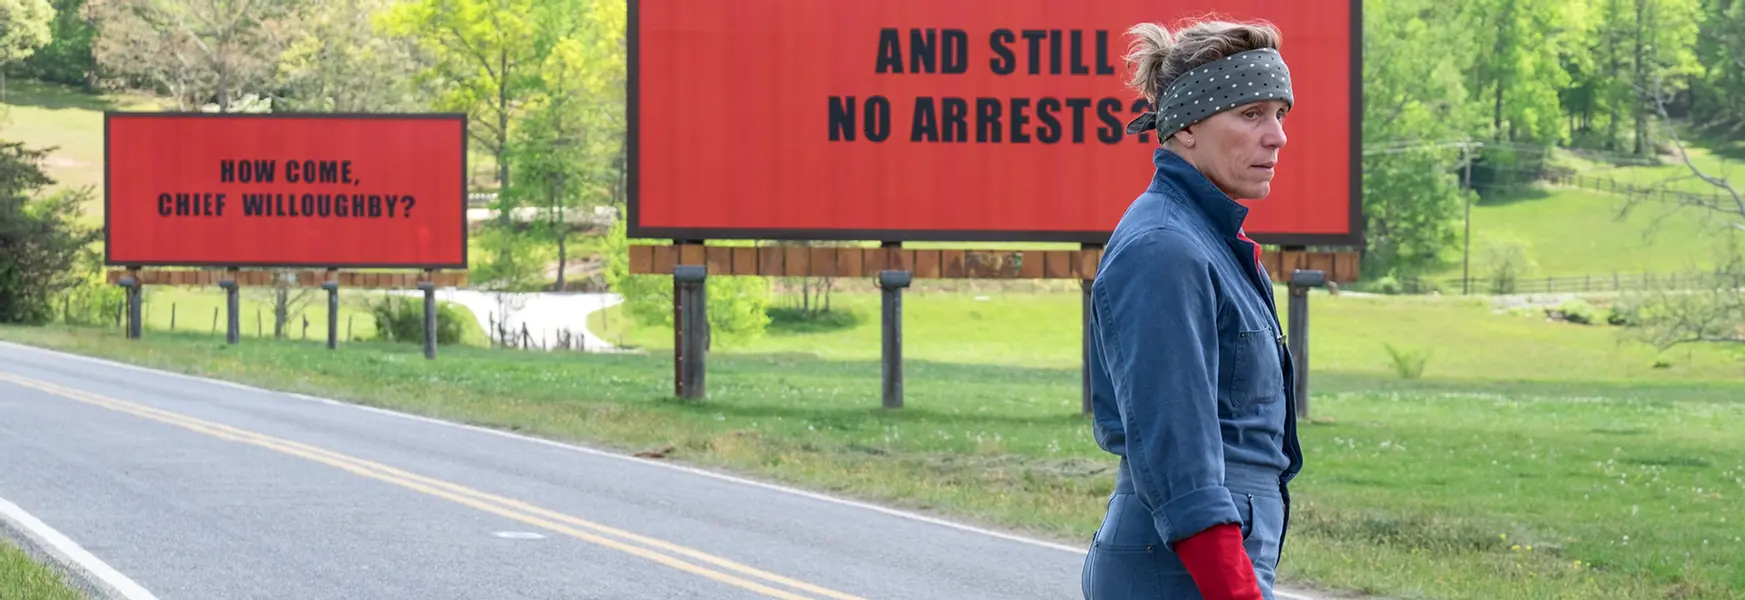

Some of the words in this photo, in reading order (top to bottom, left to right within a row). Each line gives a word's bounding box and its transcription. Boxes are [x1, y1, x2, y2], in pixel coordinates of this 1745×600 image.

[875, 28, 969, 75] AND
[989, 28, 1115, 77] STILL
[828, 95, 892, 143] NO
[220, 159, 276, 184] HOW
[285, 159, 360, 187] COME,
[157, 192, 226, 217] CHIEF
[242, 192, 417, 219] WILLOUGHBY?
